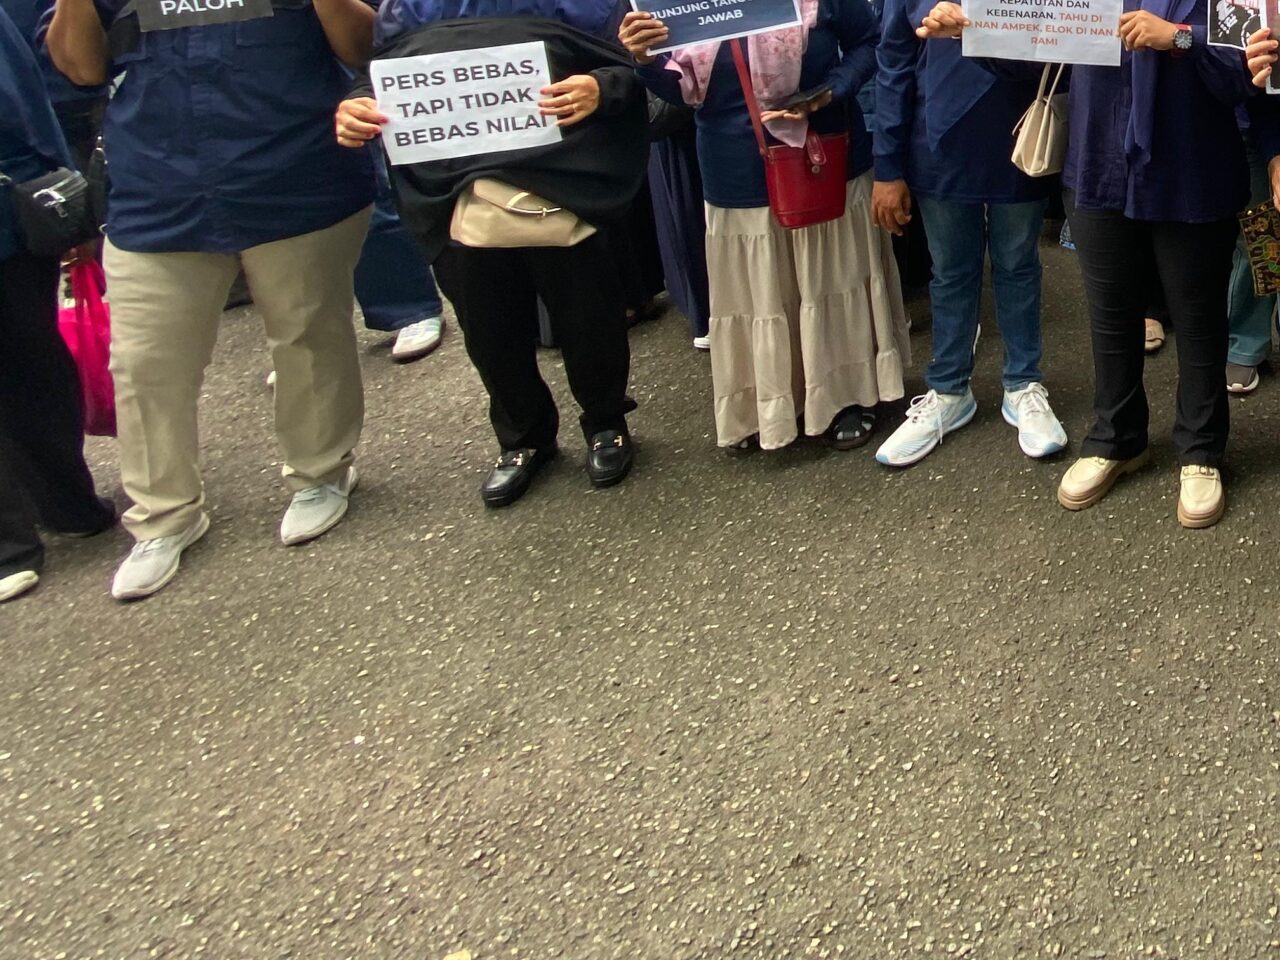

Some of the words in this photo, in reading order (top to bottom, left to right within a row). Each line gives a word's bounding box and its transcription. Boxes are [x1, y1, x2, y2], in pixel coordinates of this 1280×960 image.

[1067, 0, 1090, 8] DAN
[698, 10, 743, 26] JAWAB
[987, 9, 1056, 19] KEBENARAN.
[1059, 13, 1088, 21] TAHU
[1091, 15, 1102, 23] DI
[975, 21, 998, 29] NAN
[1046, 25, 1072, 34] ELOK
[1091, 28, 1113, 36] NAN
[1031, 37, 1058, 45] RAMI
[381, 71, 445, 91] PERS
[453, 60, 540, 82] BEBAS,
[397, 98, 453, 118] TAPI
[459, 88, 534, 109] TIDAK
[395, 122, 479, 146] BEBAS
[486, 114, 547, 134] NILAI
